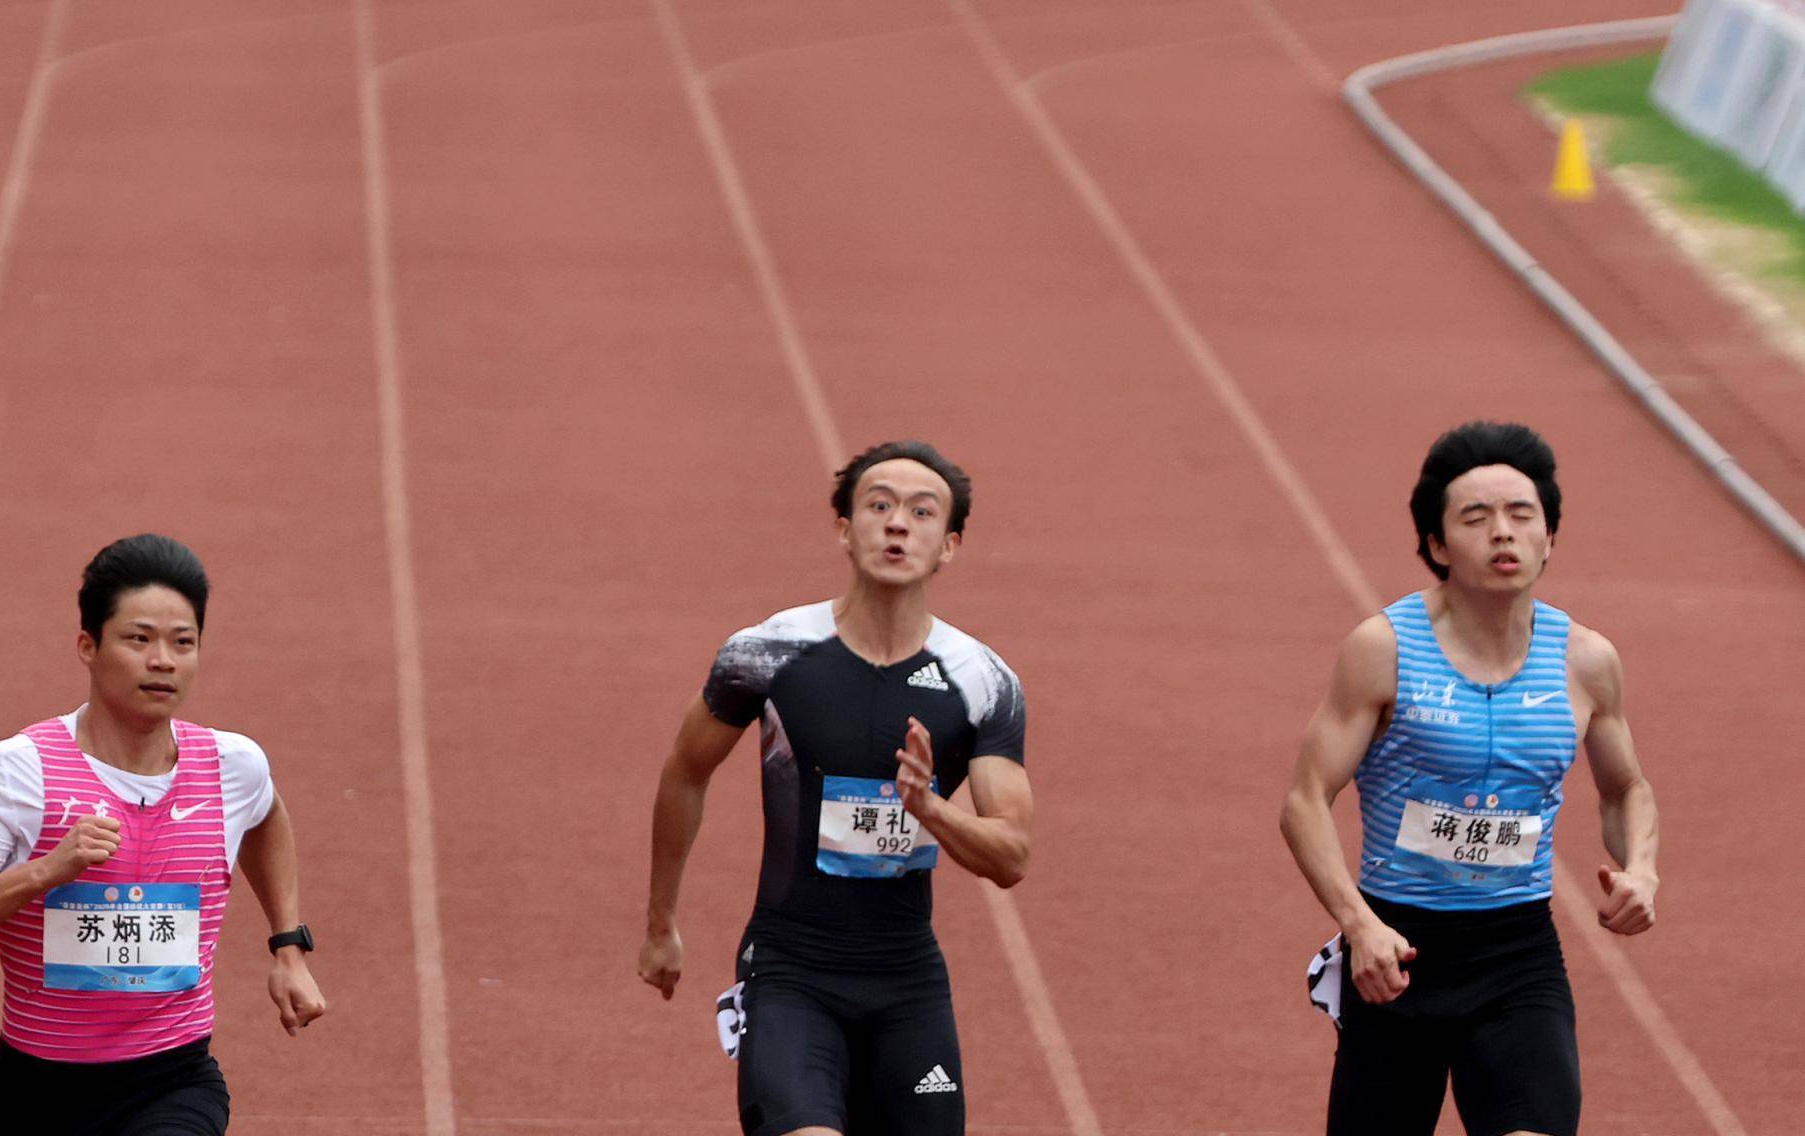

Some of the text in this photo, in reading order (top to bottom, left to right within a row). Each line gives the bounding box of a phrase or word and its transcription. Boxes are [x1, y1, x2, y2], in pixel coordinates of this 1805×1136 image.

[851, 806, 911, 834] 谭礼
[1431, 812, 1522, 847] 蒋俊鹏
[876, 837, 912, 854] 992
[1453, 845, 1489, 862] 640
[76, 914, 176, 943] 苏炳添
[106, 946, 141, 964] 181
